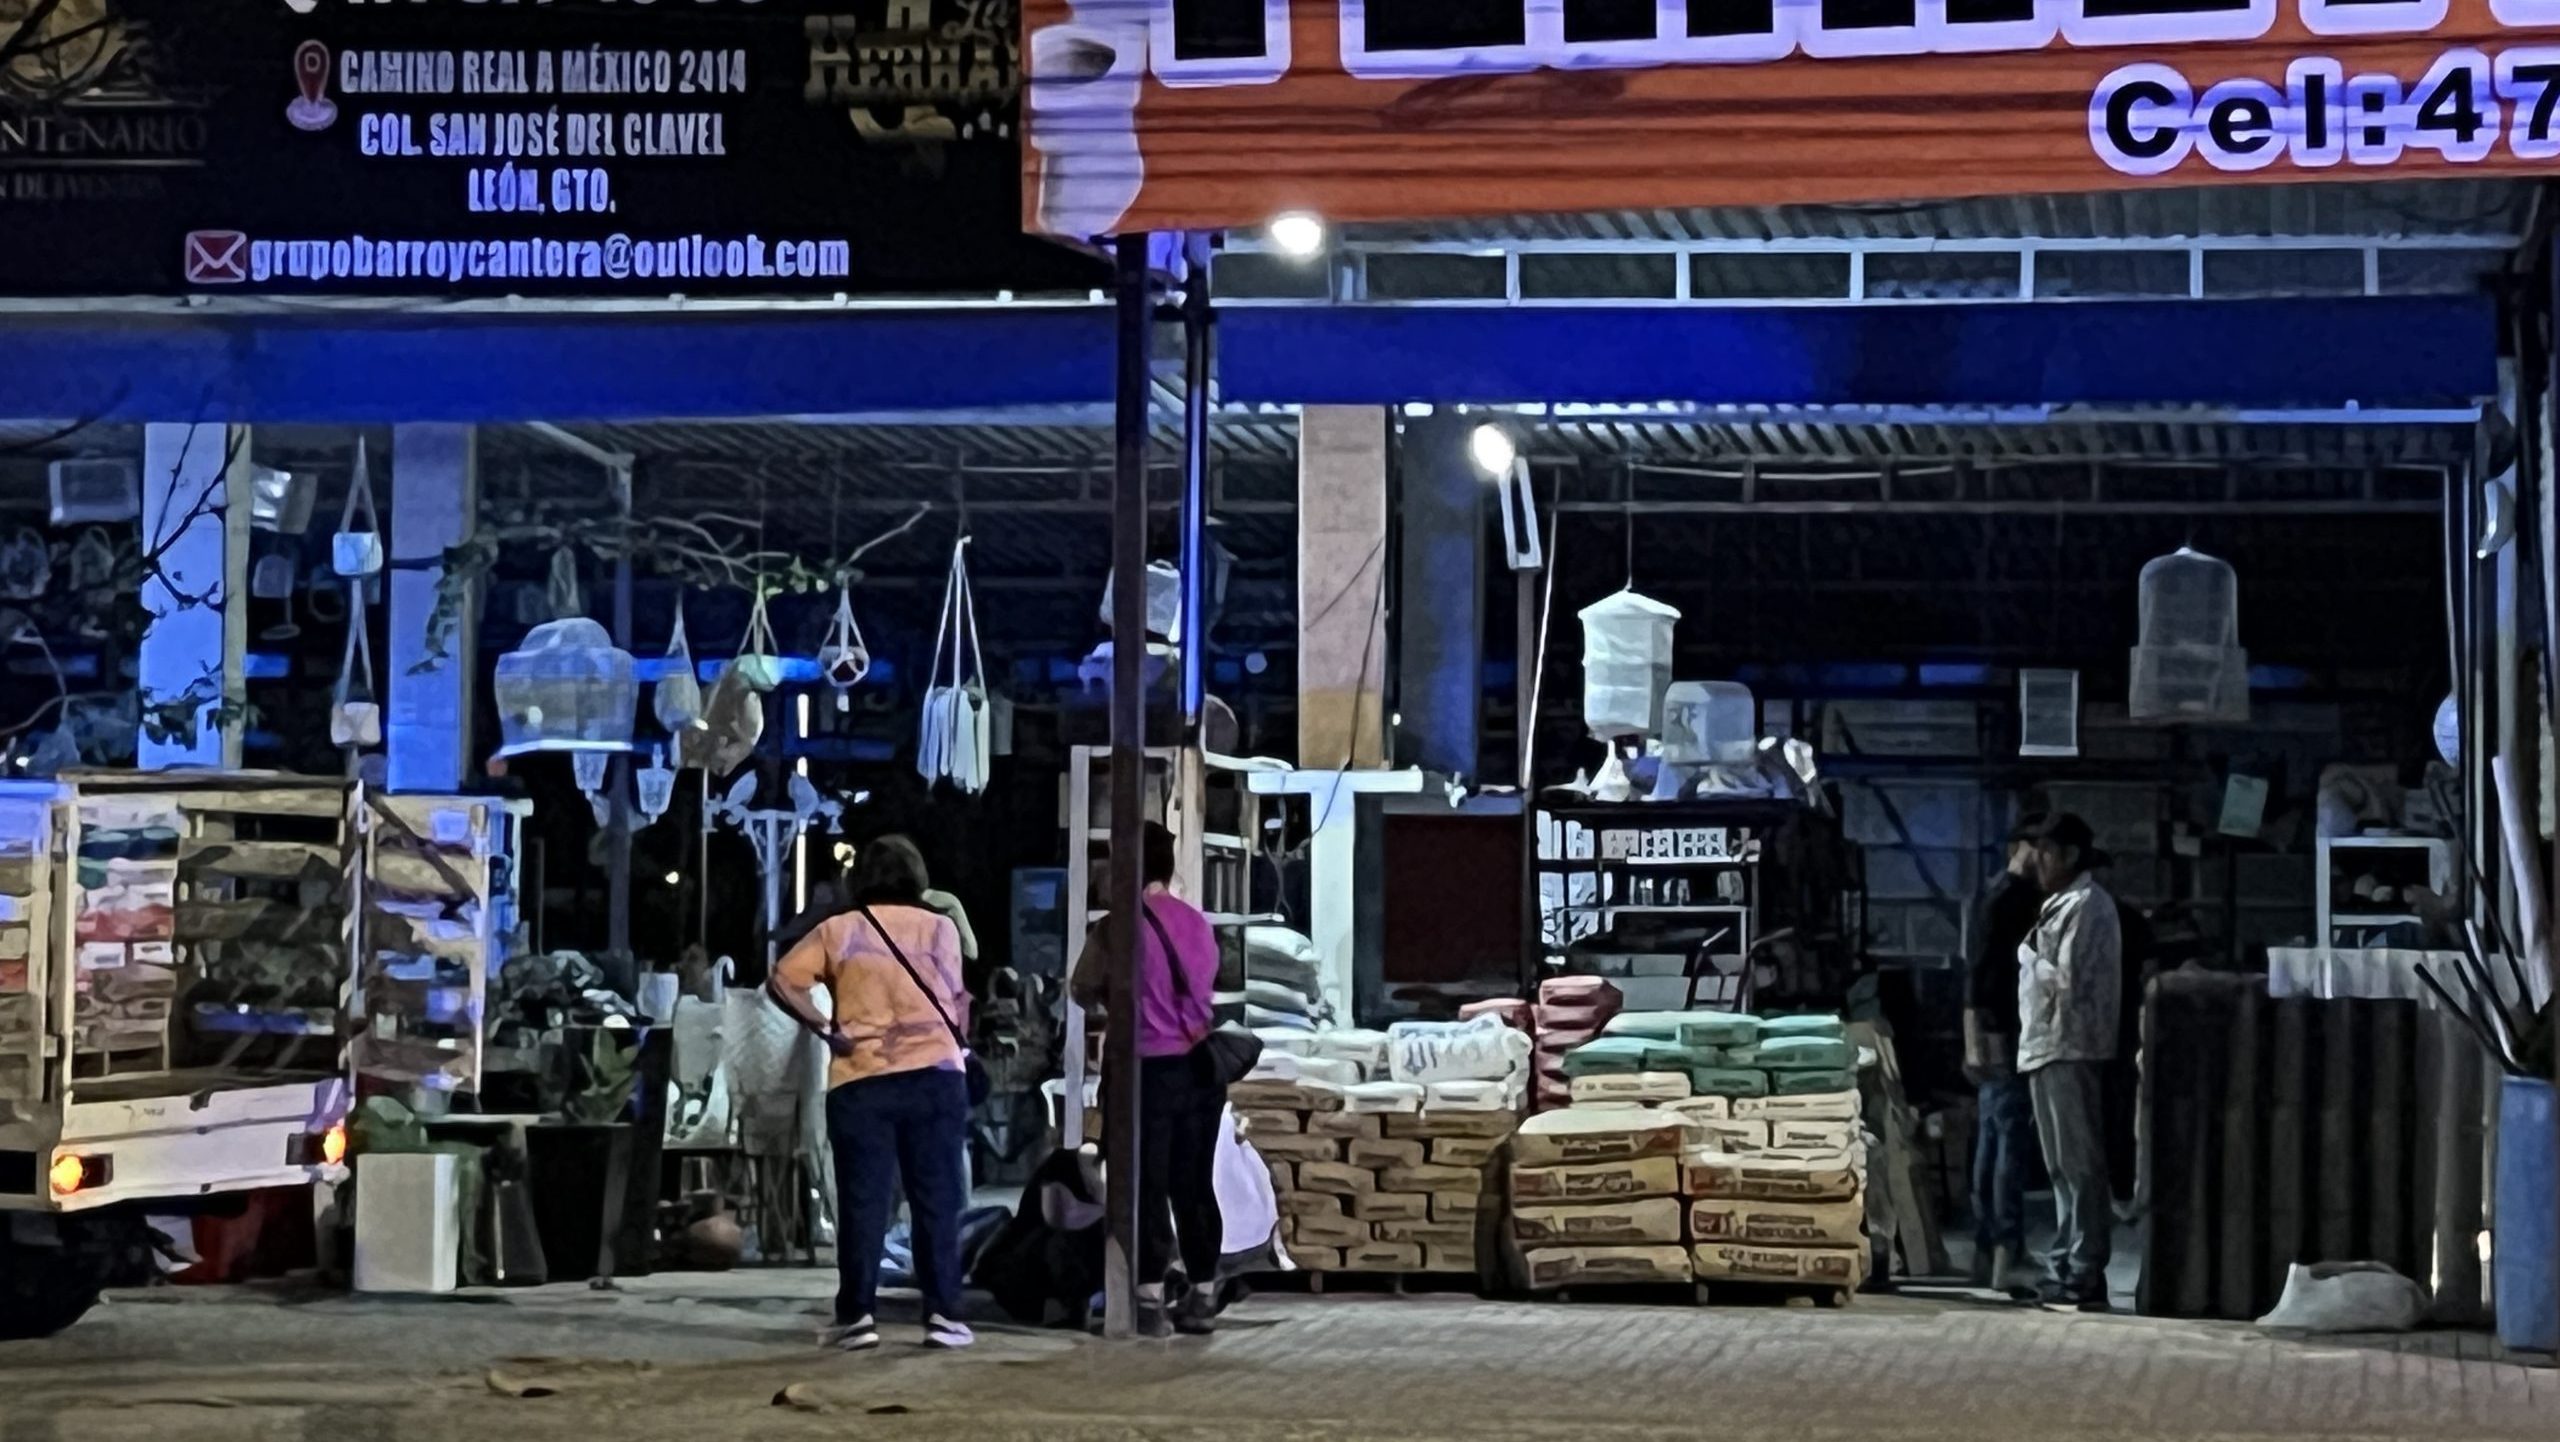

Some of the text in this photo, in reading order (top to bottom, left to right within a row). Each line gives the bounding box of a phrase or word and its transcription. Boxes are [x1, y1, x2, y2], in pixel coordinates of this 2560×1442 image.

[341, 42, 746, 93] CAMINO REAL A MÉXICO 2414
[429, 112, 487, 156] SAN
[493, 105, 560, 156] JOSÉ
[567, 112, 617, 156] DEL
[624, 112, 726, 156] CLAVEL
[551, 167, 617, 214] GTO.
[250, 233, 850, 283] grupobarroycantera@outlook.com
